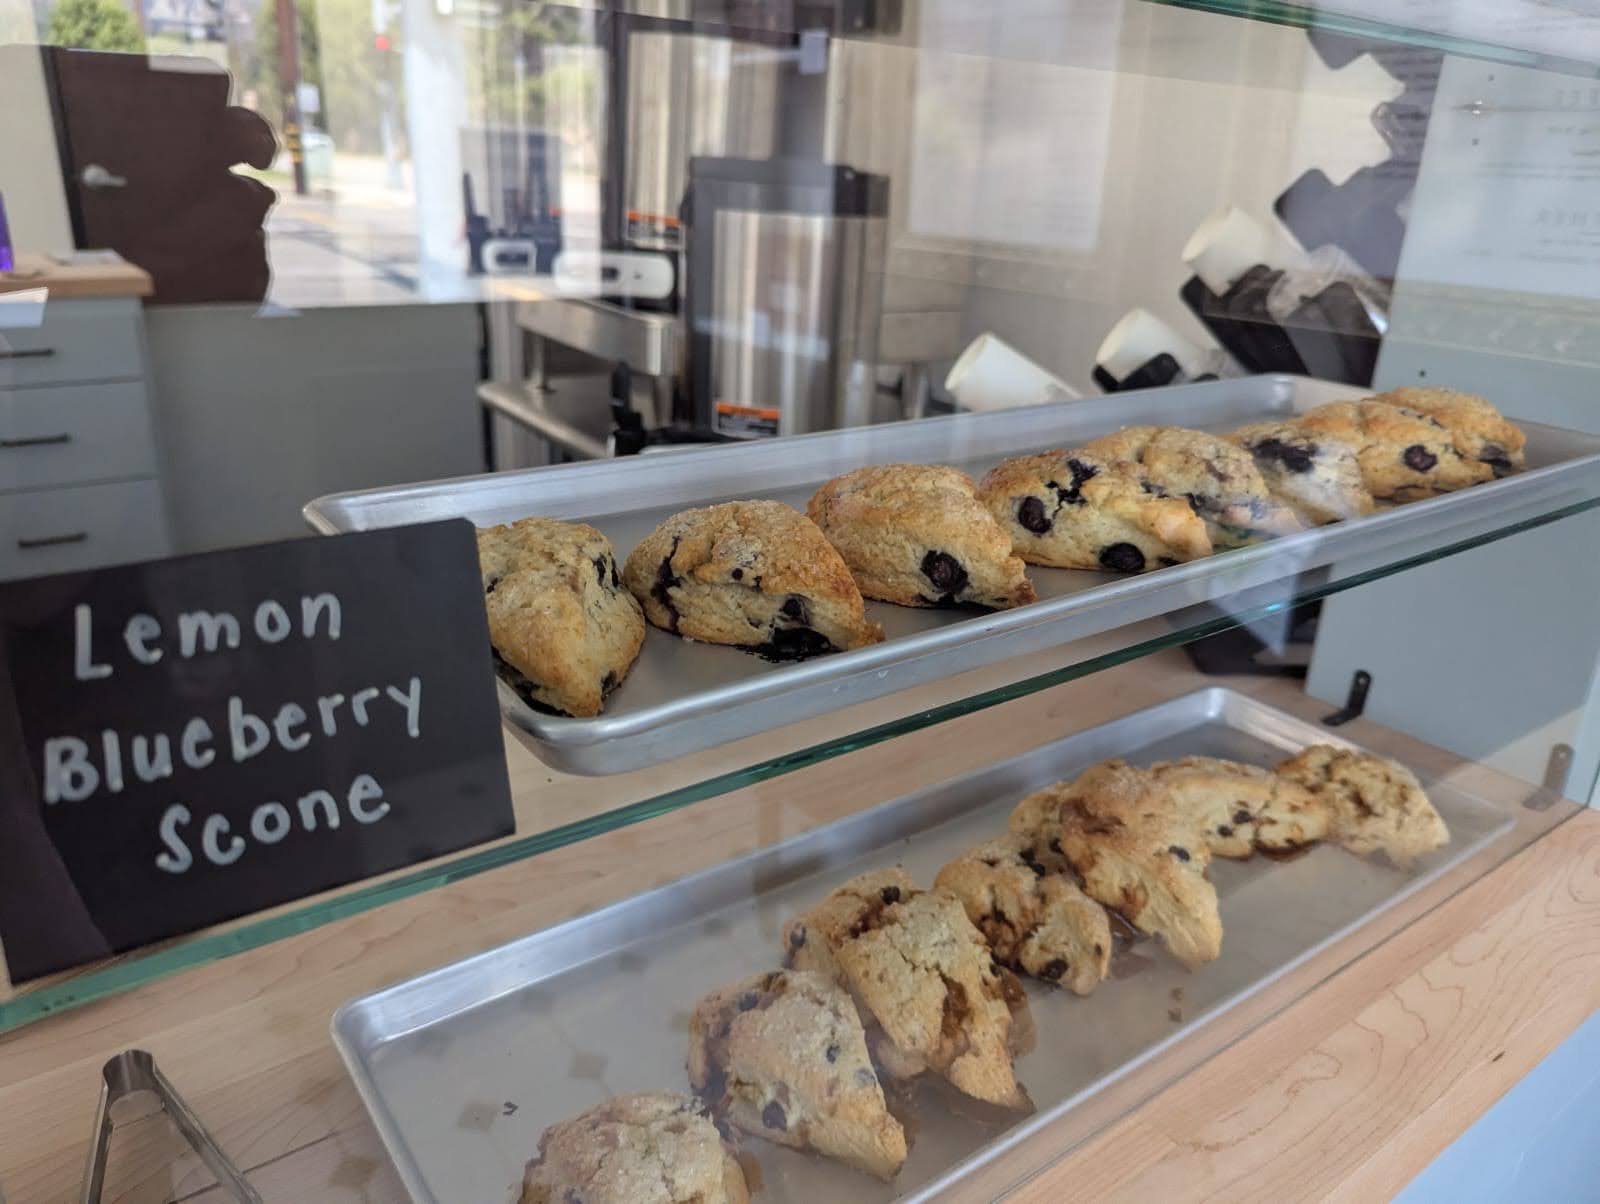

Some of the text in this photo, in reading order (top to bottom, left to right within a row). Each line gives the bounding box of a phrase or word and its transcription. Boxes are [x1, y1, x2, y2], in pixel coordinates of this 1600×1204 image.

[75, 592, 342, 680] Lemon
[44, 677, 422, 803] Blueberry
[155, 774, 392, 873] Scone
